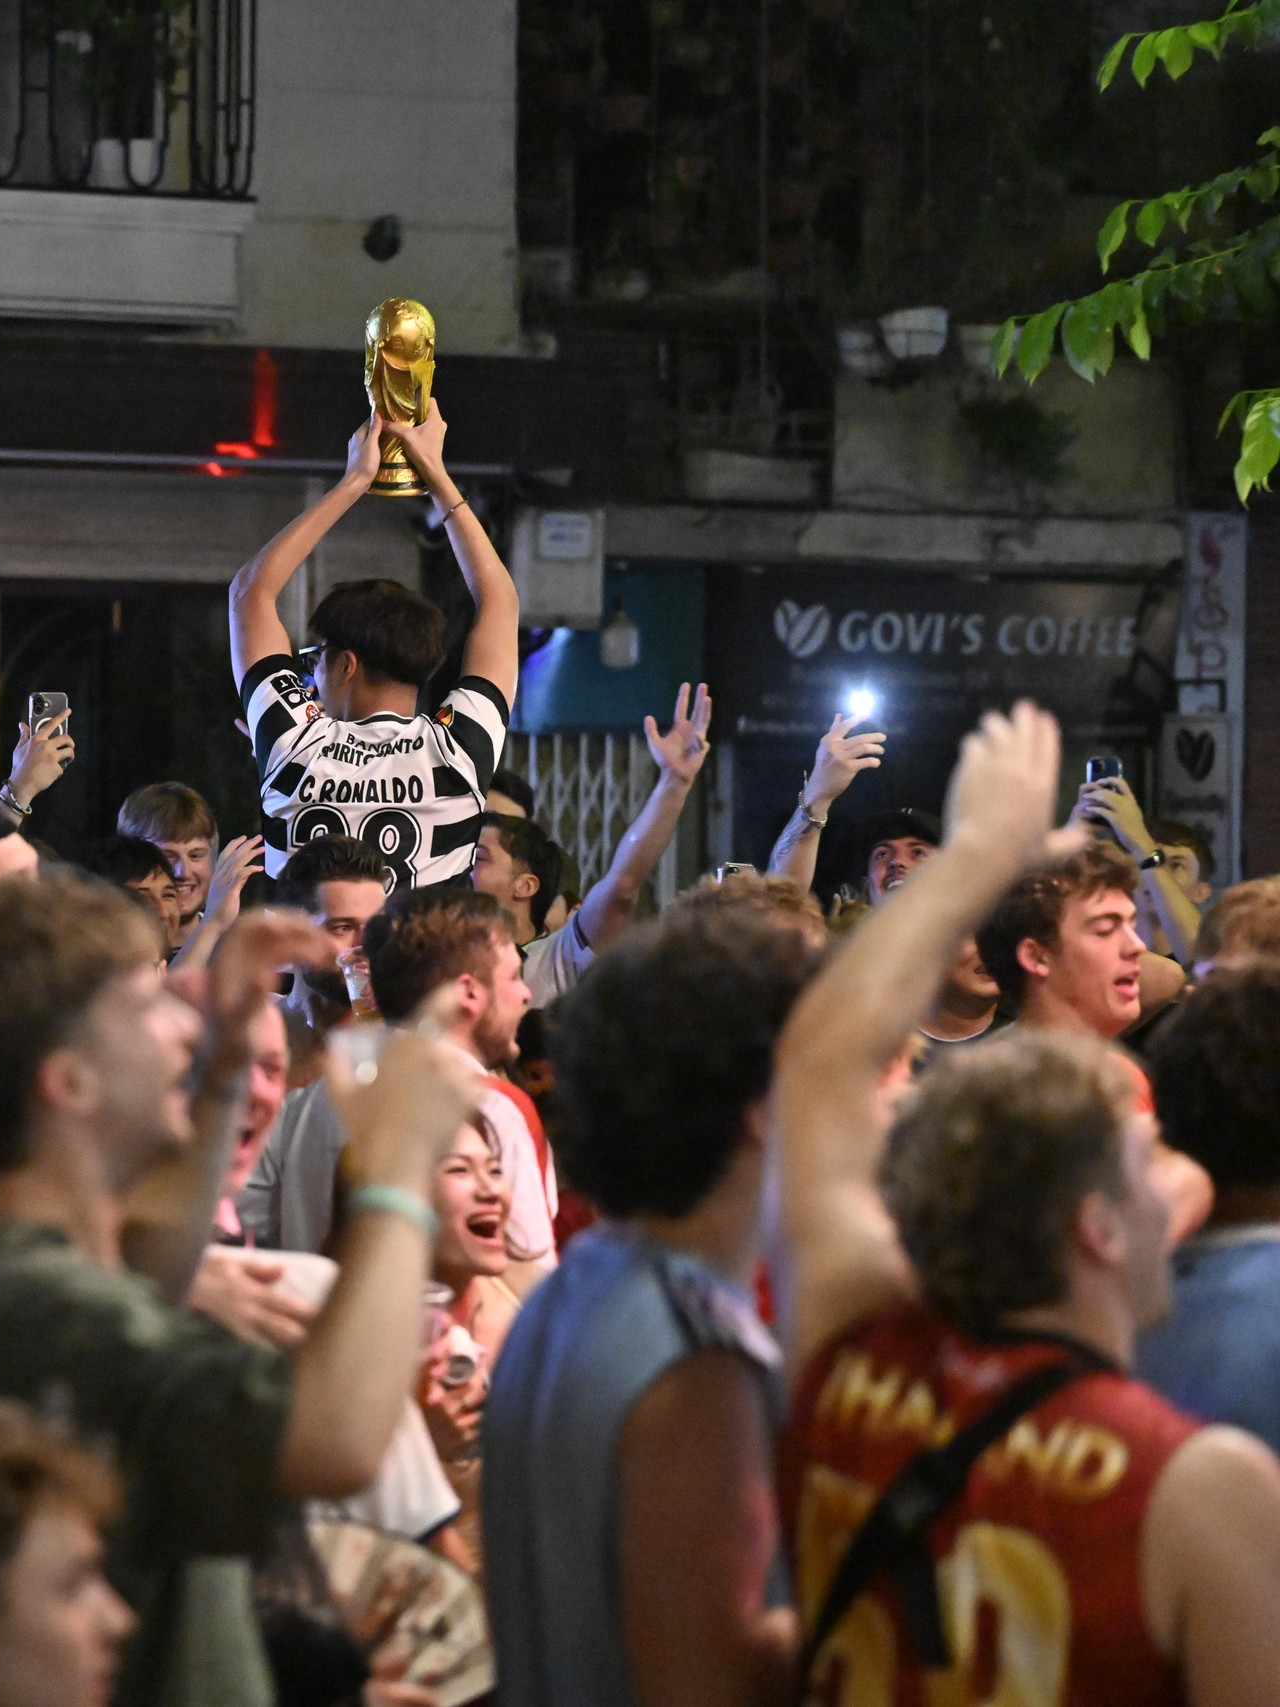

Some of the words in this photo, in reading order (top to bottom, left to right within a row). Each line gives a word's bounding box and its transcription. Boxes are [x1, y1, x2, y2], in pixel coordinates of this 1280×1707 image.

[837, 610, 984, 656] GOVI'S
[997, 614, 1137, 658] COFFEE
[298, 774, 424, 804] C.RONALDO
